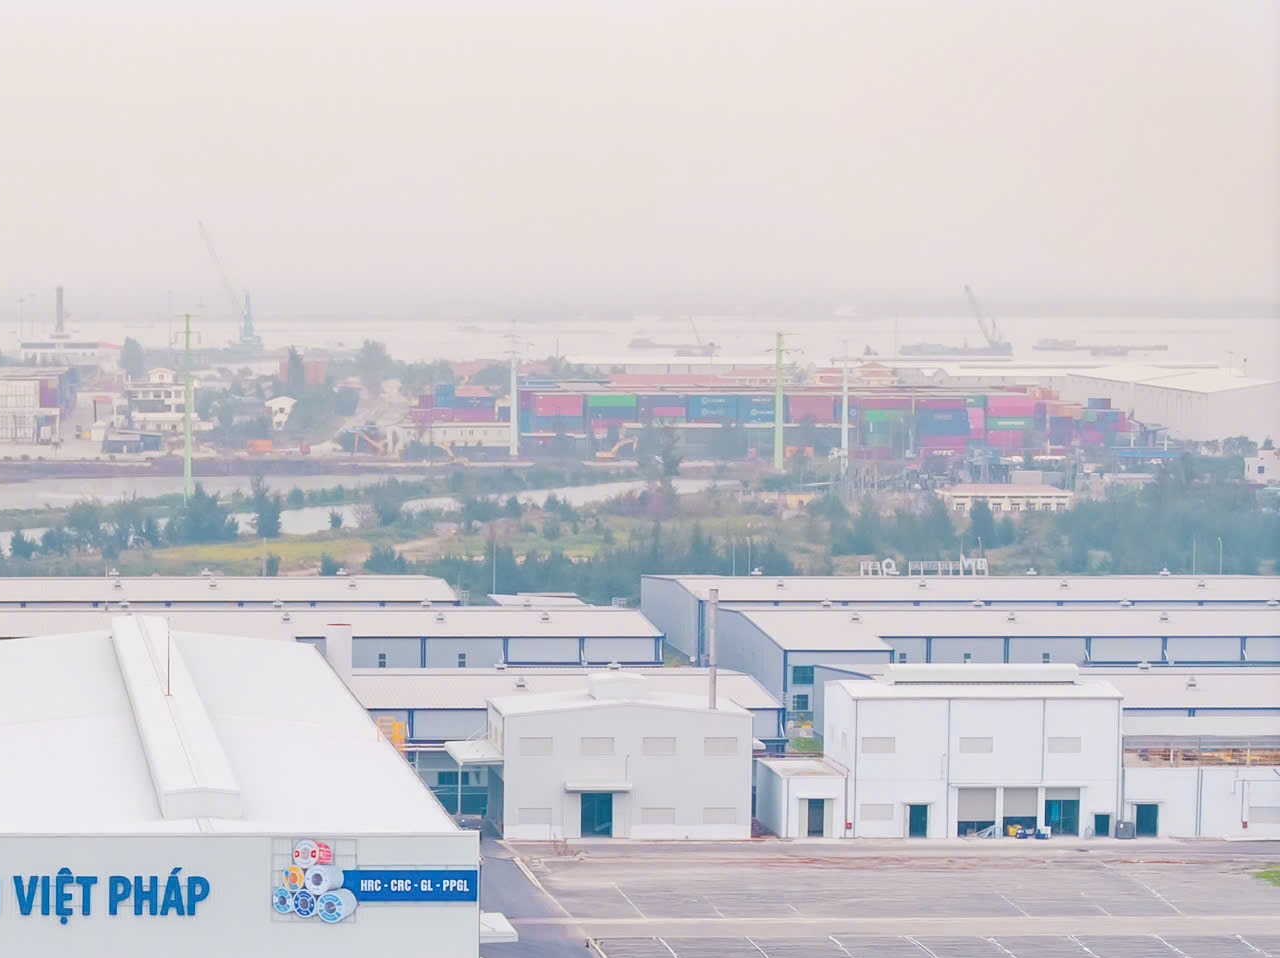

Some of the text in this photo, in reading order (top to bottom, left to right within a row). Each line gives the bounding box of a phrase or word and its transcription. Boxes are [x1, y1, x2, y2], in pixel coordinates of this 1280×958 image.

[13, 866, 98, 925] VIỆT
[108, 867, 211, 916] PHÁP
[360, 879, 381, 892] HRC
[390, 879, 412, 892] CRC
[420, 879, 433, 892] GL
[442, 879, 470, 892] PPGL
